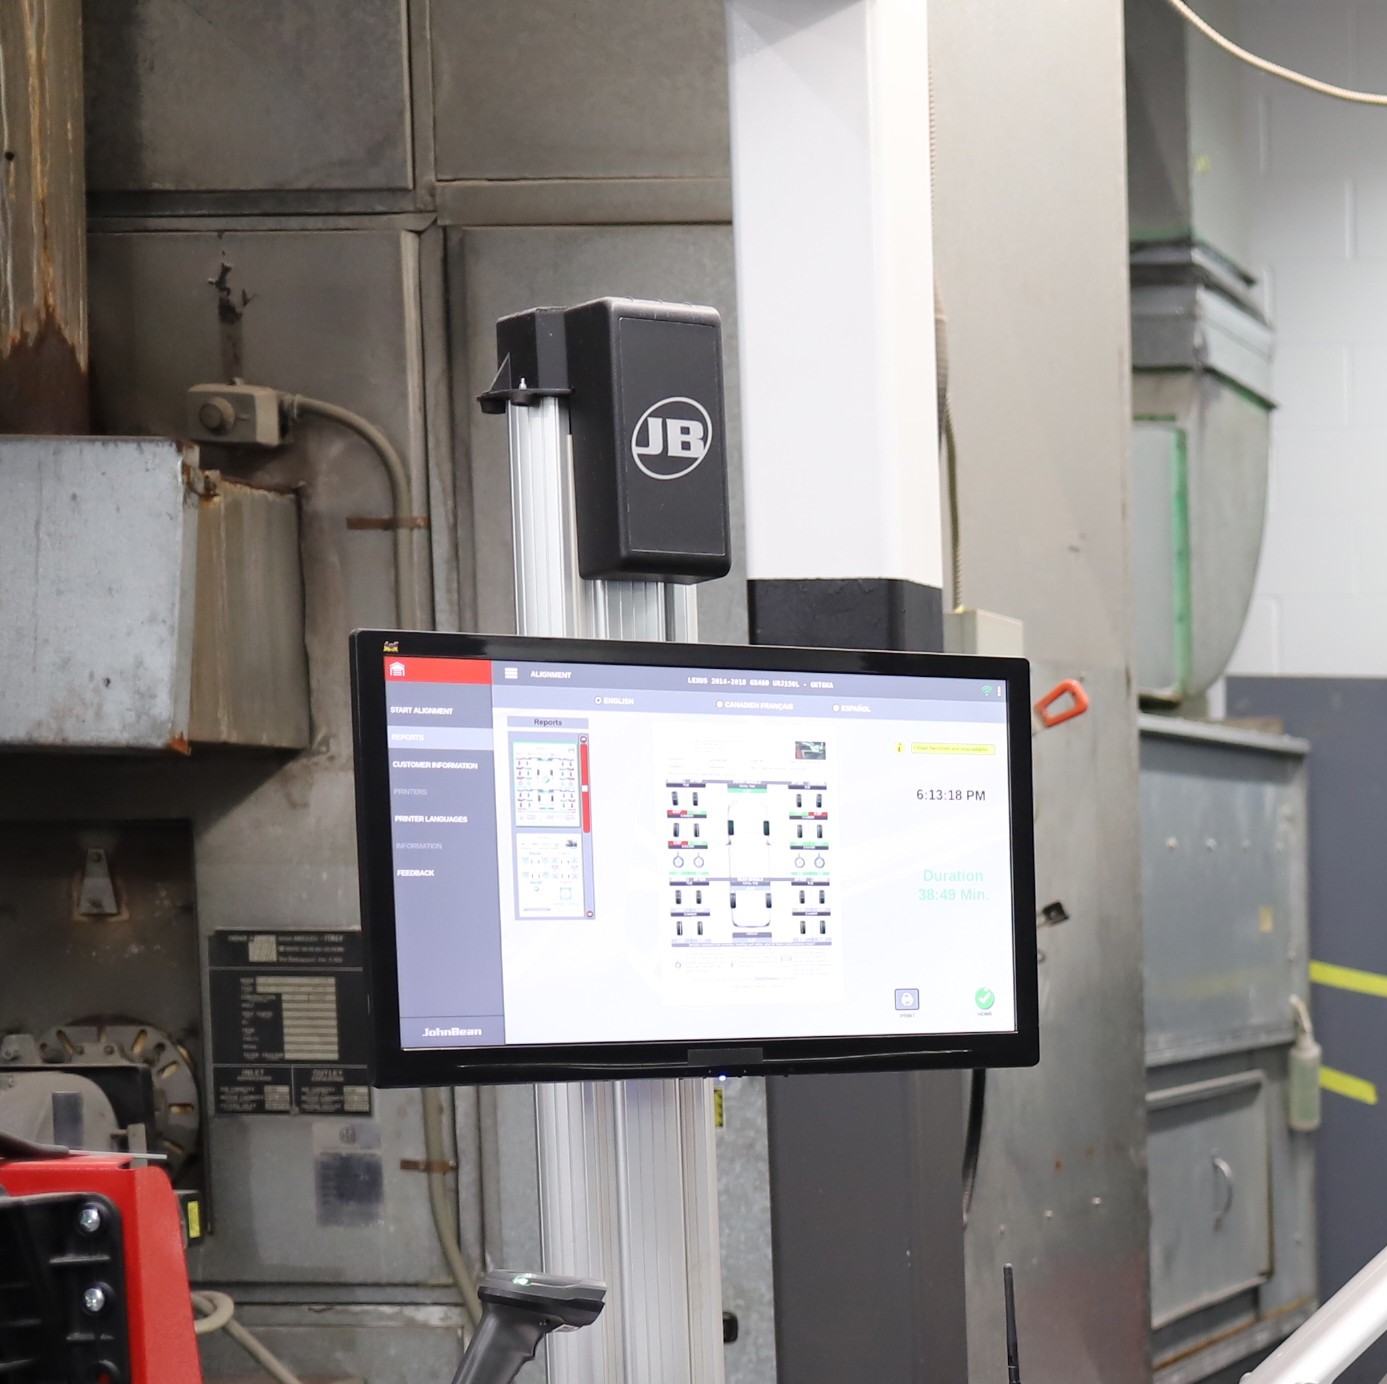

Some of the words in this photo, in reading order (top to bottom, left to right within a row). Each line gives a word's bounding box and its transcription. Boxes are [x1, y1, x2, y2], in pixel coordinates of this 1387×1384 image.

[635, 416, 705, 459] JB
[530, 670, 572, 679] ALIGNMENT
[687, 676, 708, 685] LEXUS
[603, 697, 635, 705] ENGLISH
[390, 706, 412, 714] START
[413, 707, 453, 715] ALIGNMENT
[724, 701, 759, 710] CANADIEN
[760, 702, 794, 711] FRANÇAIS
[840, 703, 871, 713] ESPAÑOL
[533, 718, 563, 727] Reports
[391, 733, 425, 742] REPORTS
[392, 761, 430, 769] CUSTOMER
[431, 762, 478, 770] INFORMATION
[393, 788, 428, 796] PRINTERS
[916, 788, 962, 801] 6:13:18
[966, 789, 986, 801] PM
[394, 815, 425, 823] PRINTER
[425, 815, 468, 823] LANGUAGES
[396, 842, 442, 850] INFORMATION
[397, 869, 435, 877] FEEDBACK
[923, 868, 984, 882] Duration
[918, 888, 957, 901] 38:49
[960, 888, 990, 901] Min.
[422, 1026, 482, 1037] JohnBean
